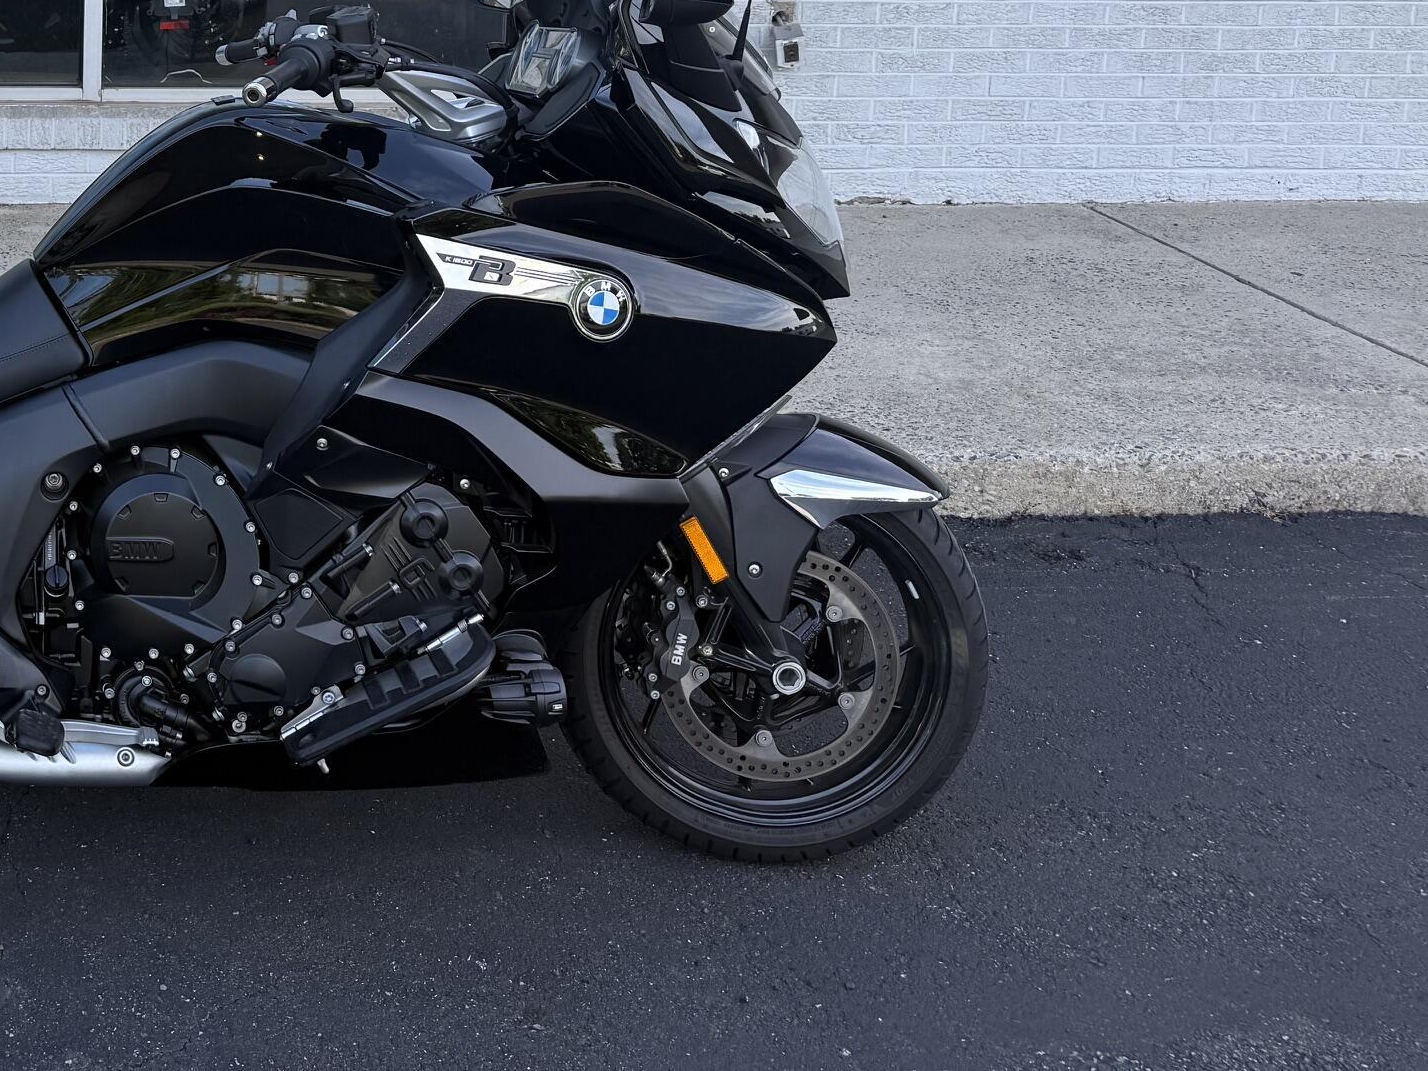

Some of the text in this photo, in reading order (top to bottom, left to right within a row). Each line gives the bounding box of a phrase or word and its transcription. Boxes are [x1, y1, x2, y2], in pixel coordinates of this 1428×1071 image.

[584, 281, 627, 302] BMW
[107, 541, 161, 560] BMW
[671, 632, 688, 666] BMW
